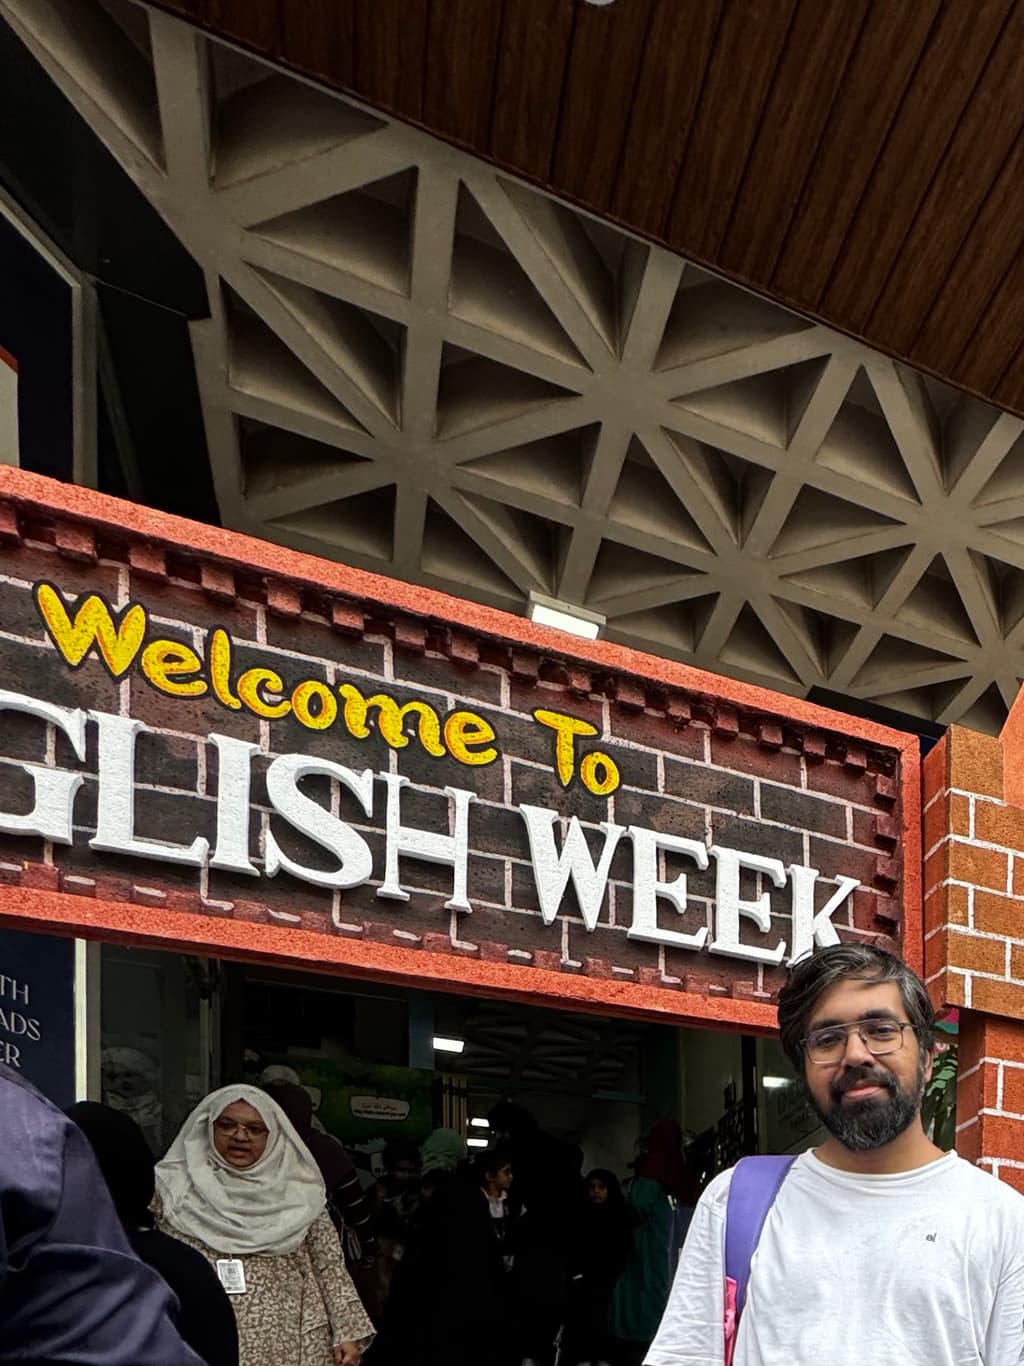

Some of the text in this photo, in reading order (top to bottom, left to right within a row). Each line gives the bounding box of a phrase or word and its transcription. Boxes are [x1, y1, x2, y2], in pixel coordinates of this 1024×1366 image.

[36, 582, 621, 796] Welcome To
[0, 690, 861, 967] GLISH WEEK
